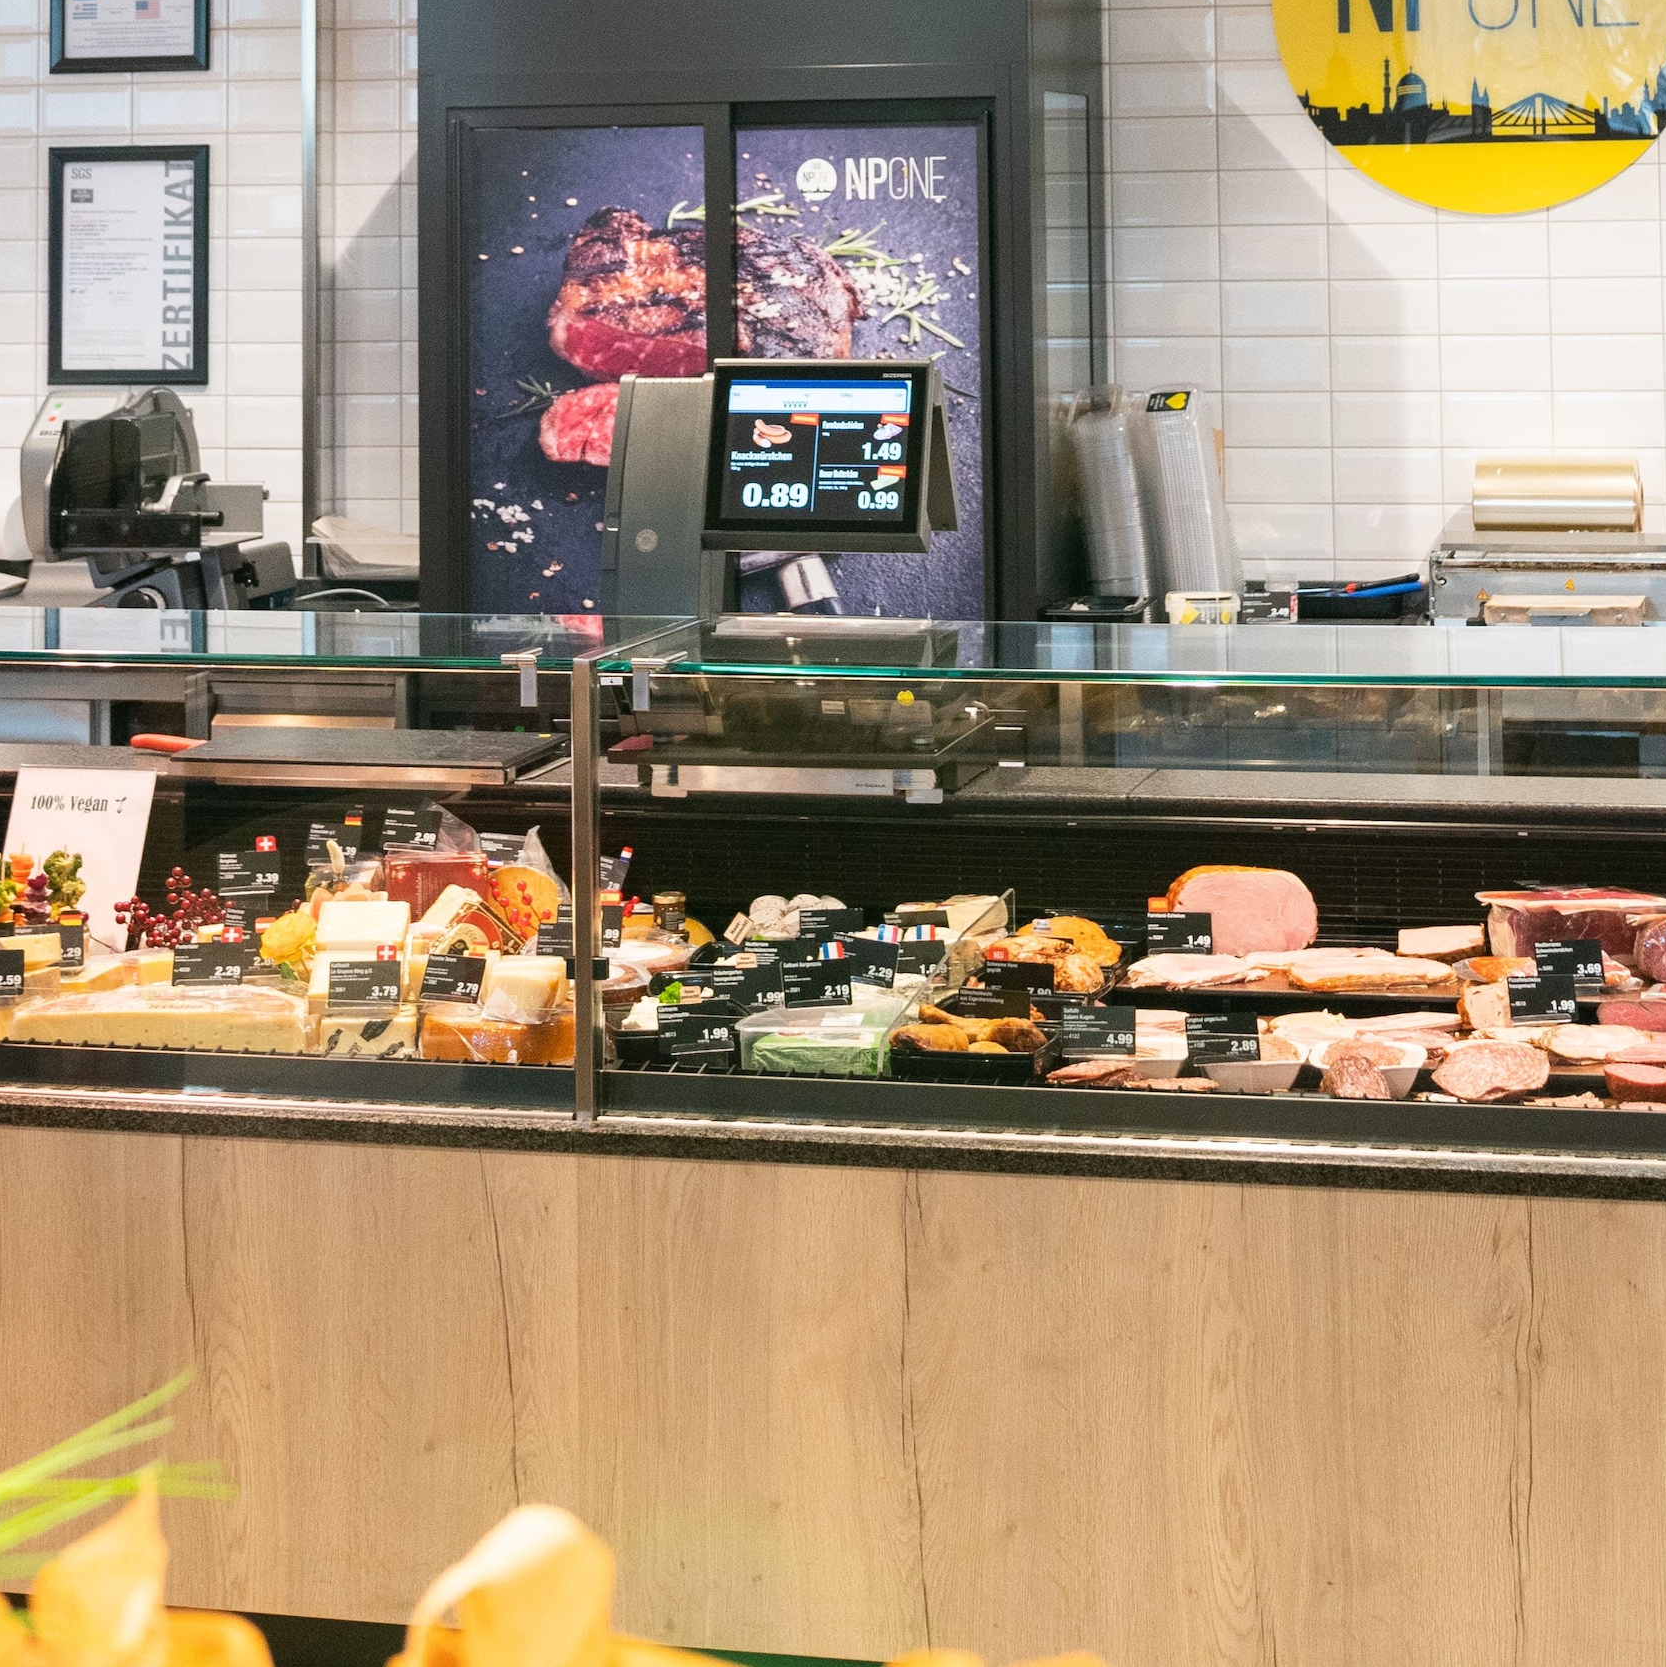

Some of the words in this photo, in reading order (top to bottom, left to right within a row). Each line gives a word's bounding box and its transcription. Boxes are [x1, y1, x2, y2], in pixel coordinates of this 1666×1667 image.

[71, 168, 92, 179] SGS
[162, 160, 194, 370] ZERTIFIKAT
[731, 451, 792, 461] Knackwürstchen
[862, 442, 902, 460] 1.49
[742, 482, 809, 507] 0.89
[857, 491, 899, 509] 0.99
[30, 795, 65, 811] 100%
[70, 795, 108, 814] Vegan
[414, 832, 436, 843] 2.99
[255, 873, 279, 883] 3.39
[603, 929, 619, 939] .89
[1187, 935, 1211, 946] 1.49
[214, 966, 241, 976] 2.29
[868, 965, 892, 978] 2.29
[1577, 963, 1601, 974] 3.69
[371, 986, 398, 997] 3.79
[456, 982, 479, 994] 2.79
[825, 985, 849, 996] 2.19
[756, 992, 781, 1003] 1.99
[1550, 1000, 1575, 1011] 1.99
[702, 1027, 728, 1039] 1.99
[1107, 1034, 1133, 1044] 4.99
[1231, 1040, 1257, 1051] 2.89
